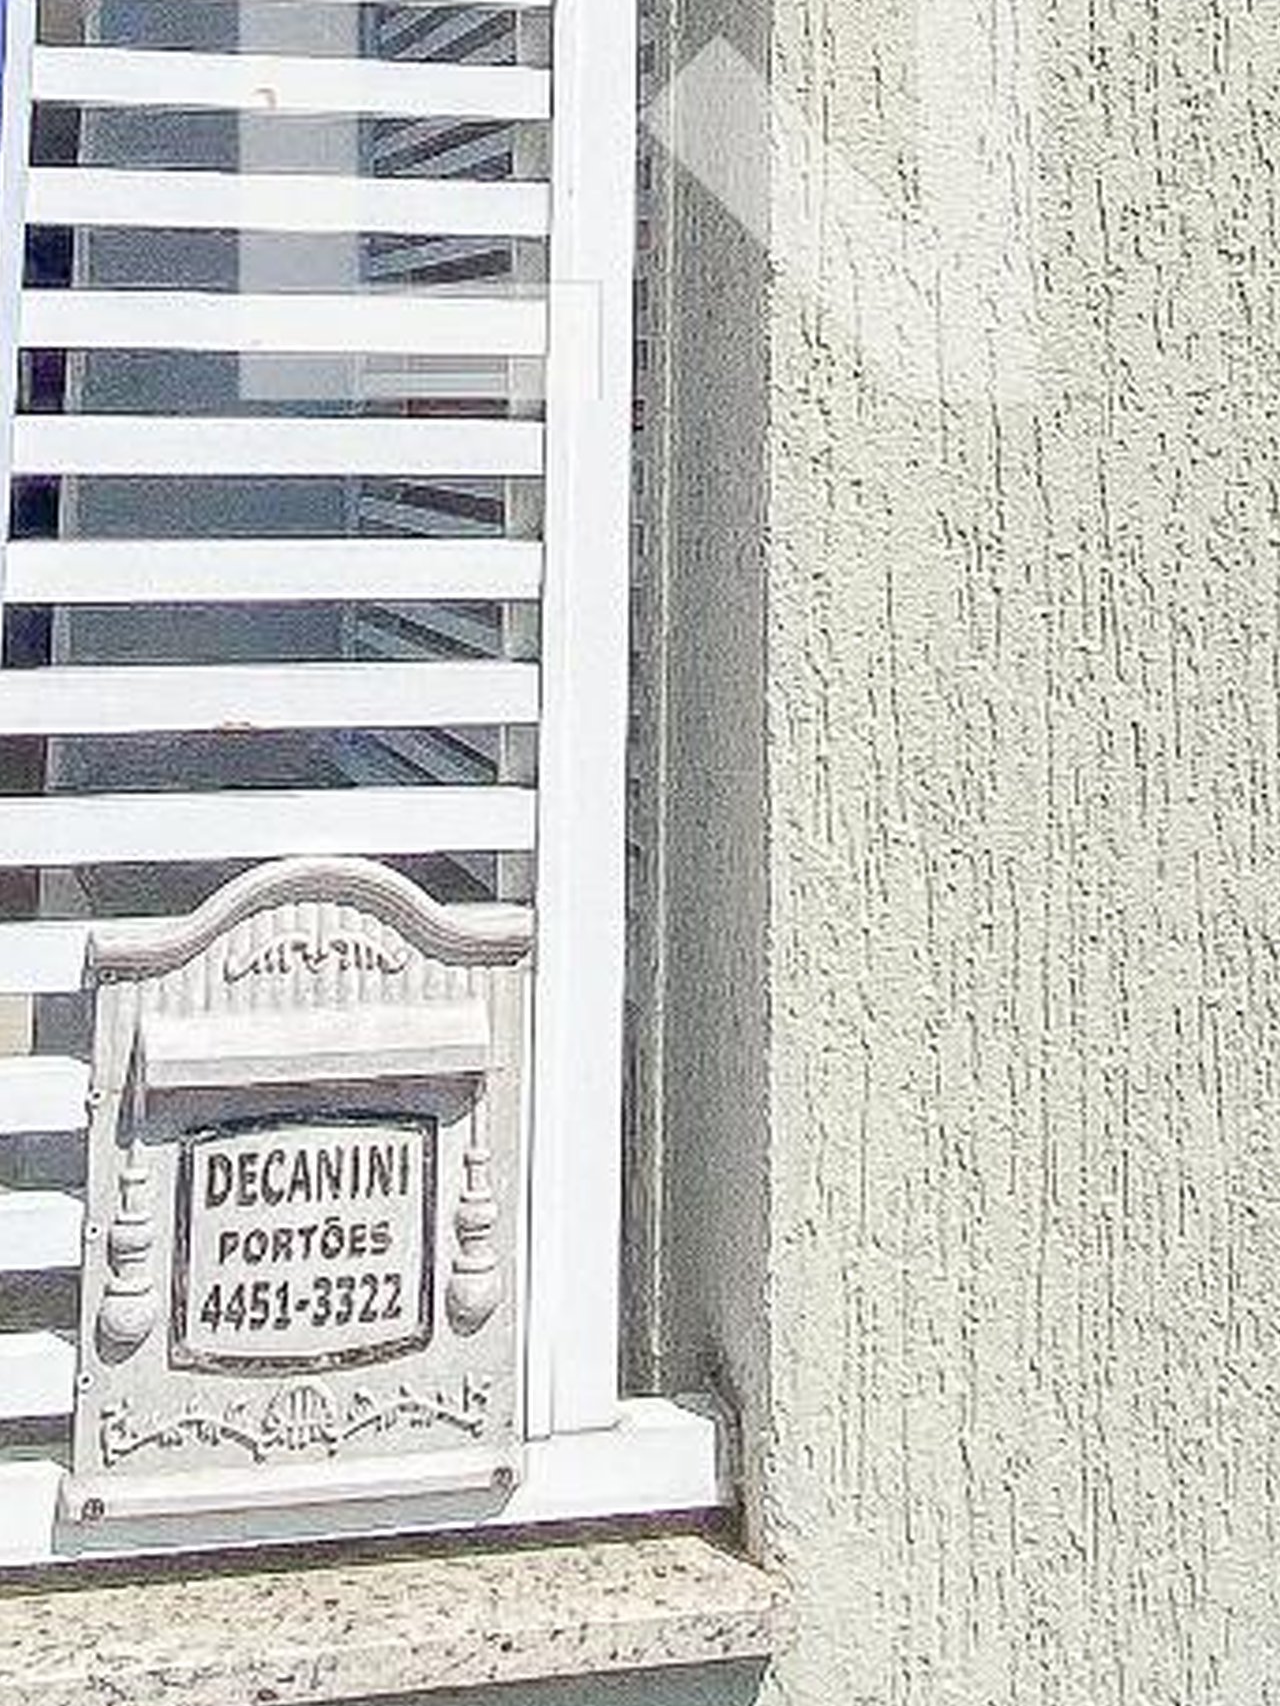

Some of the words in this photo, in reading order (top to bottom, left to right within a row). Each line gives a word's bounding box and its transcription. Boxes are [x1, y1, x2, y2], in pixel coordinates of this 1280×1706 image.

[205, 1144, 409, 1209] DECANINI
[219, 1217, 394, 1266] PORTÕES
[200, 1273, 402, 1332] 4451-3322
